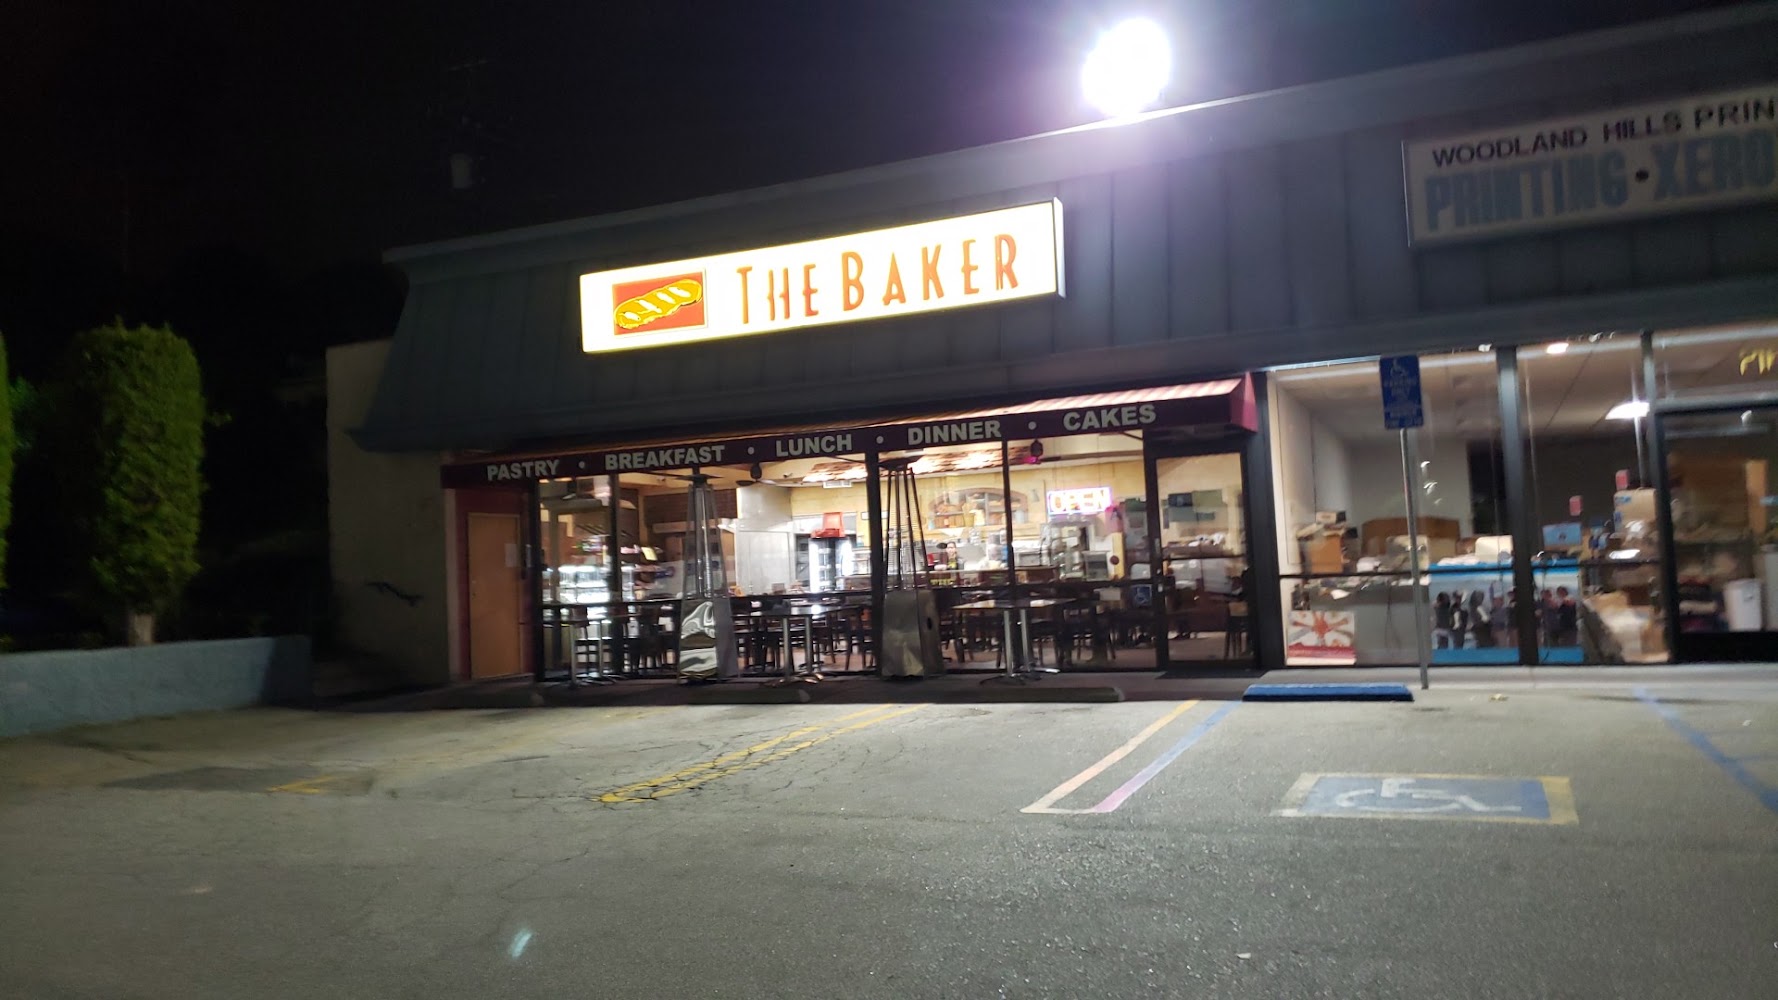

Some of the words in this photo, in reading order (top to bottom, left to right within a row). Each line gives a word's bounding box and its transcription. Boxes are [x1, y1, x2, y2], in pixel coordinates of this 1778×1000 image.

[1432, 126, 1587, 168] WOODLAND
[1603, 110, 1681, 143] HILLS
[1424, 149, 1628, 232] PRINTING
[737, 264, 819, 324] THE
[841, 234, 1019, 311] BAKER
[486, 459, 560, 481] PASTRY
[605, 445, 725, 470] BREAKFAST
[775, 434, 852, 457] LUNCH
[907, 420, 1001, 444] DINNER
[1063, 404, 1156, 431] CAKES
[1050, 489, 1108, 513] OPEN
